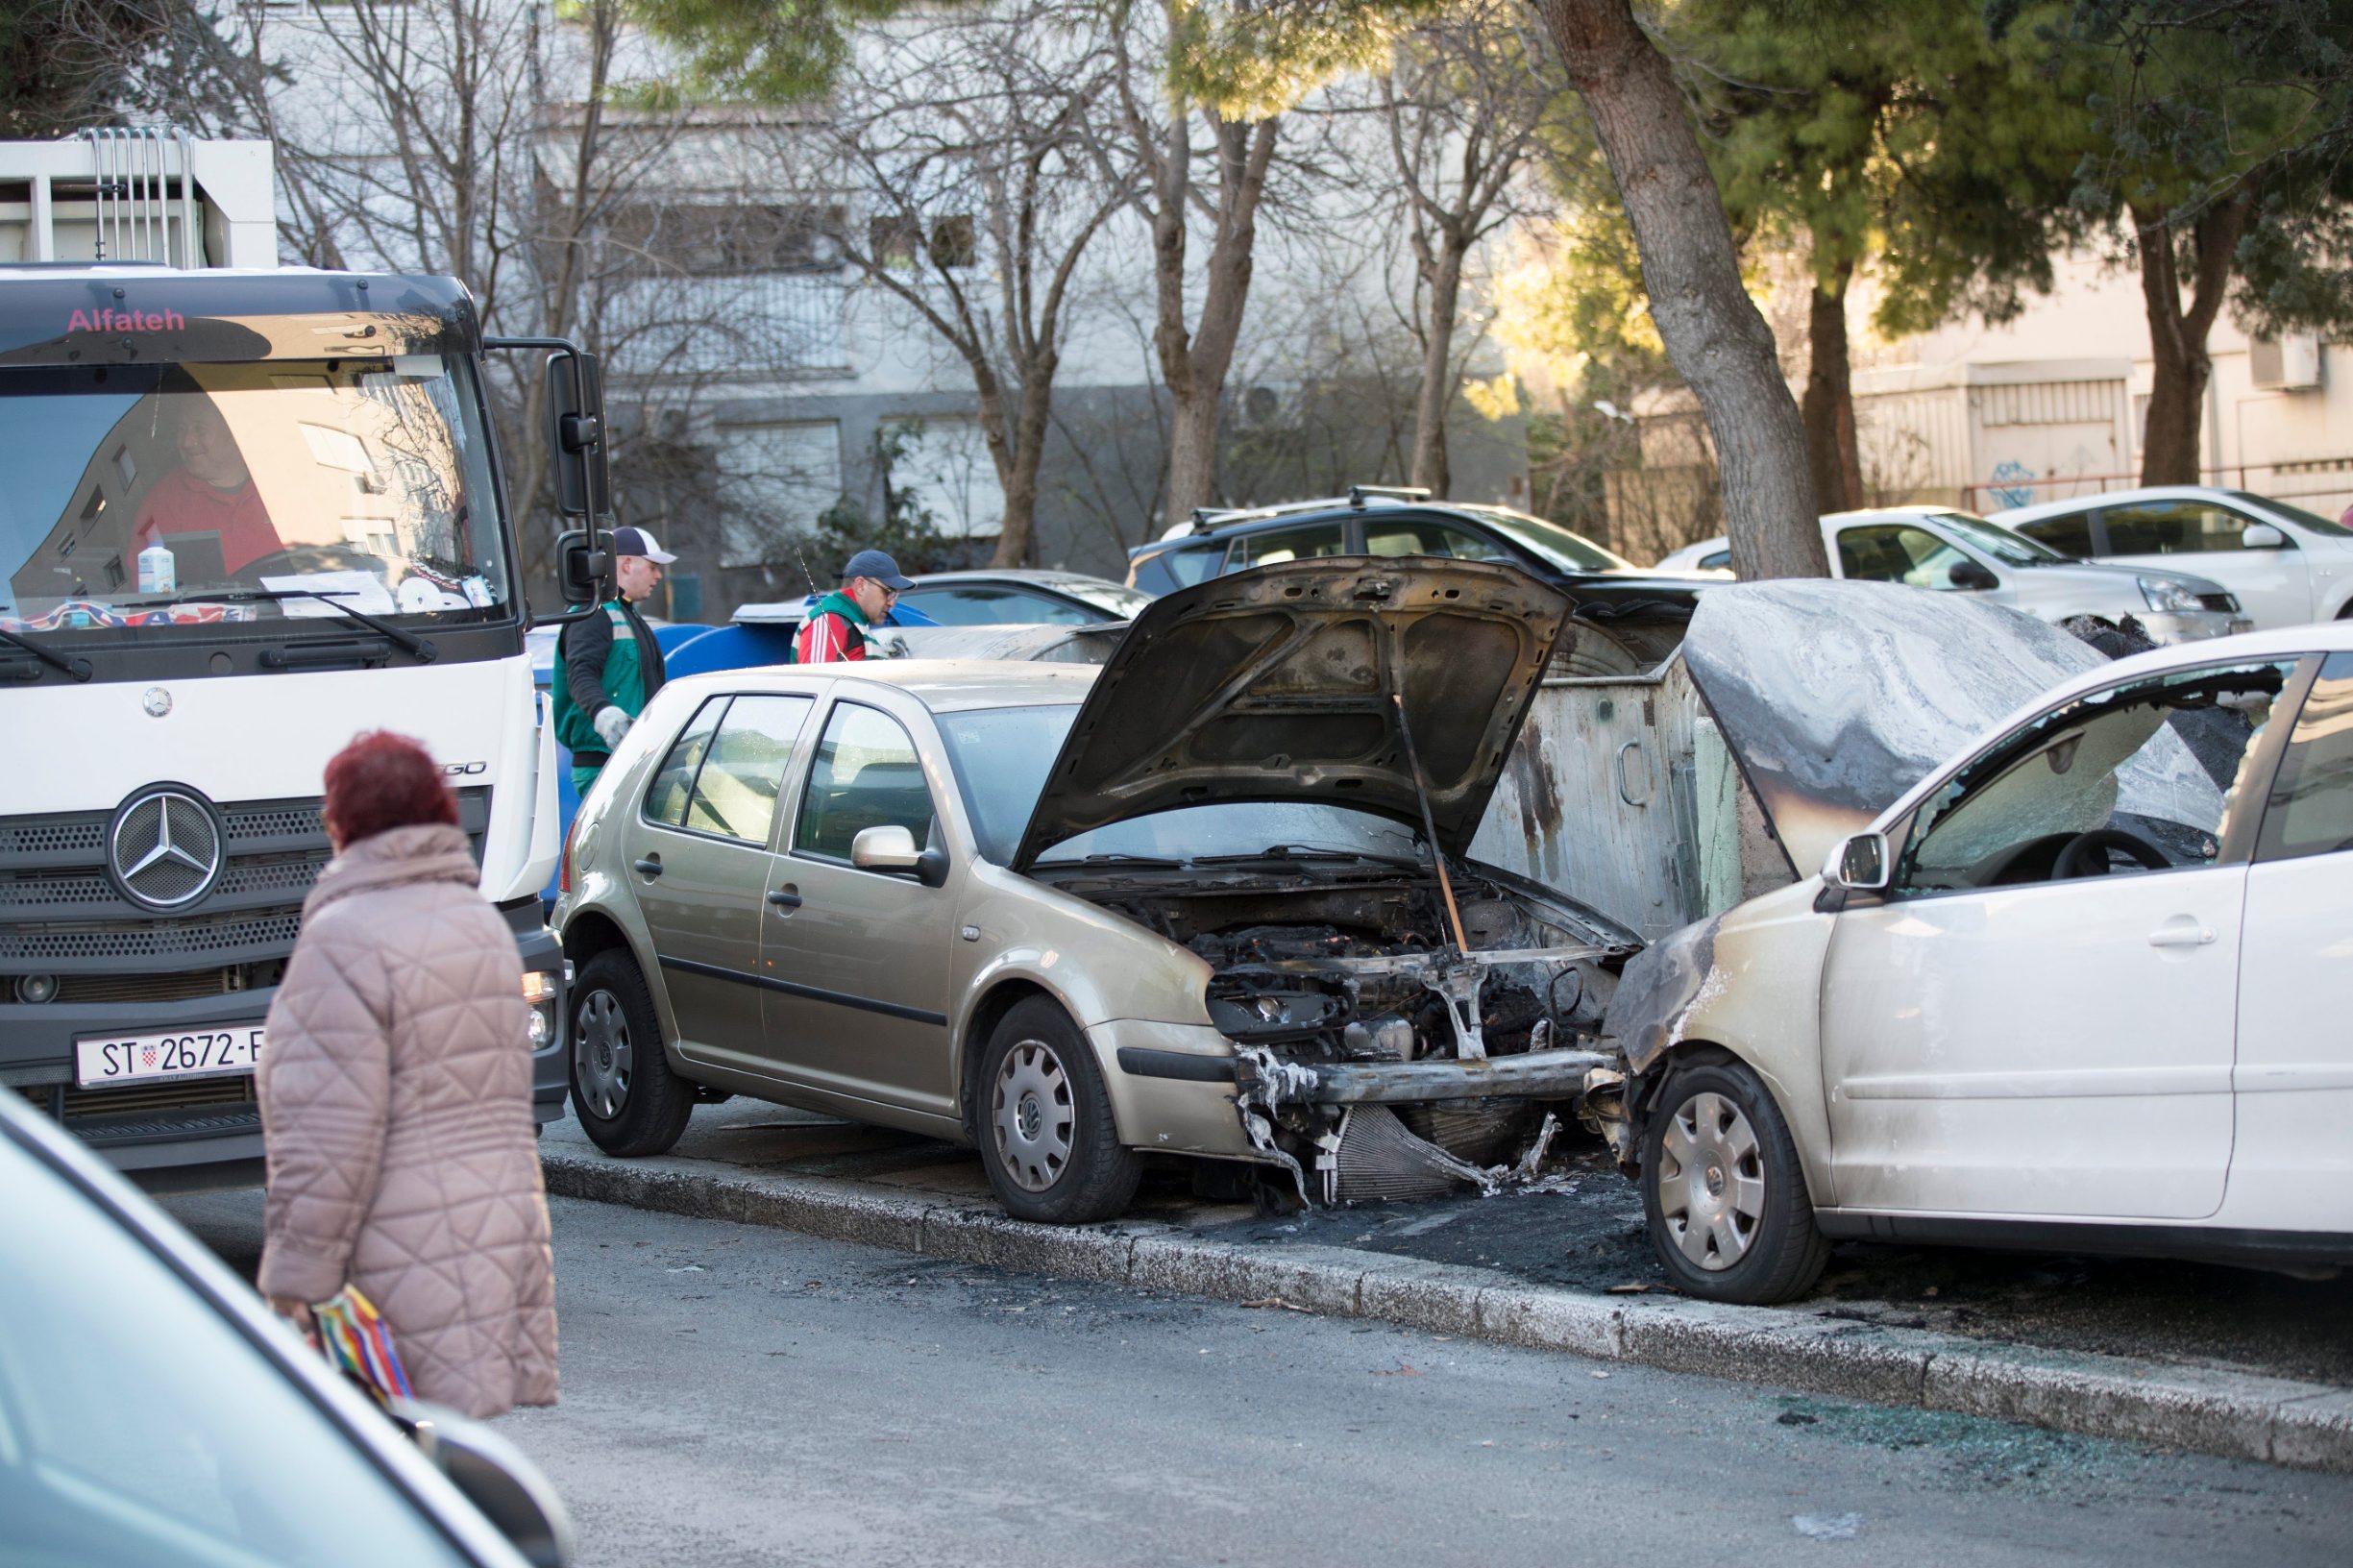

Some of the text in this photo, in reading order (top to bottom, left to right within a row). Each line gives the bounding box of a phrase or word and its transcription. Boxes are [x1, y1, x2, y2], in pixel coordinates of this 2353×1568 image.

[67, 307, 185, 331] Alfateh
[436, 761, 487, 776] GO
[102, 1041, 137, 1076] ST
